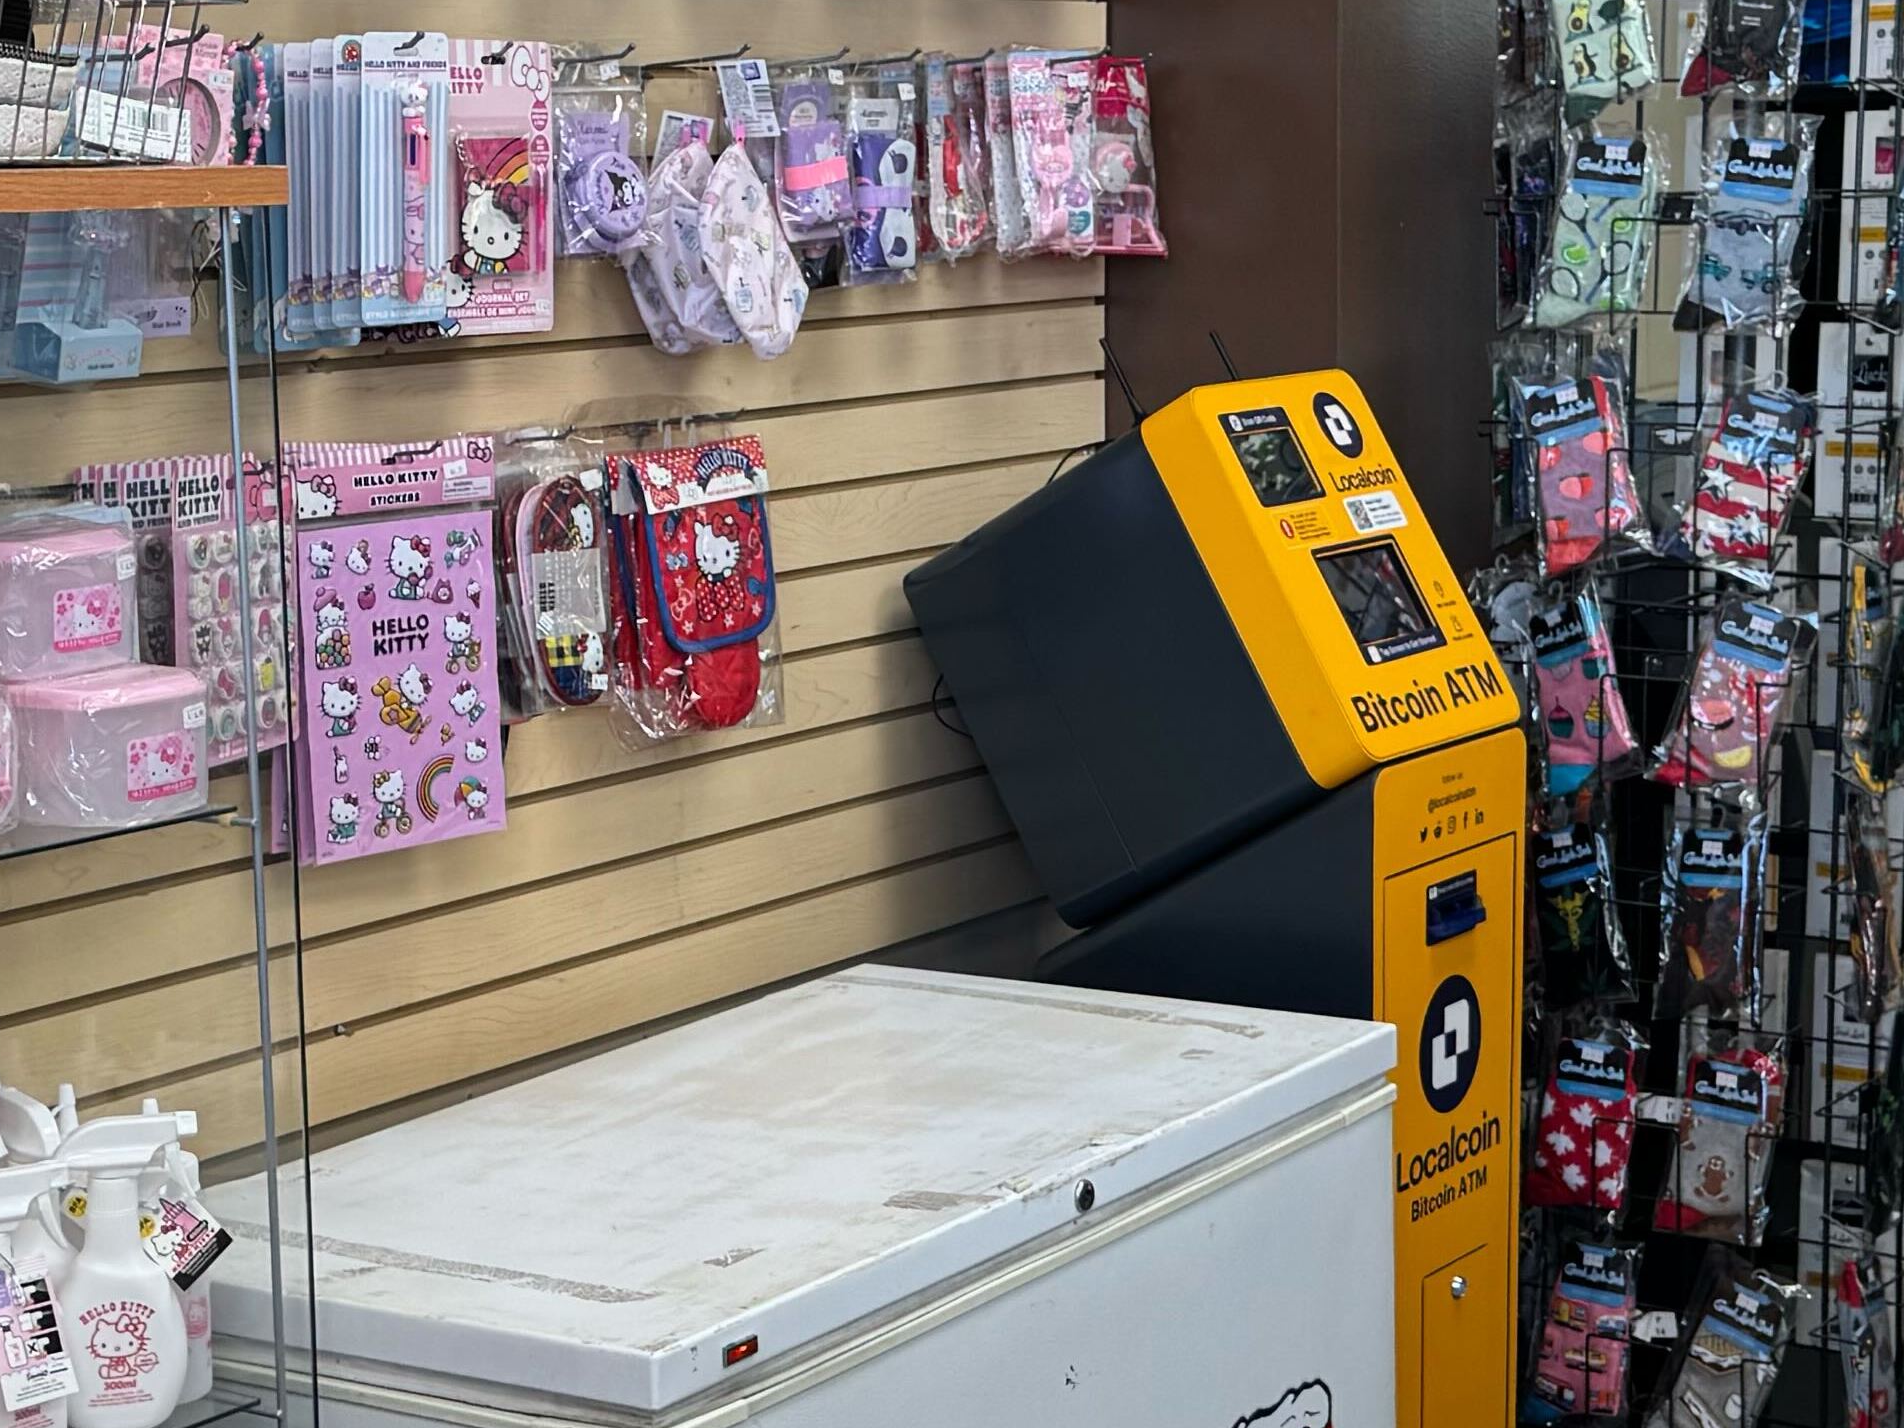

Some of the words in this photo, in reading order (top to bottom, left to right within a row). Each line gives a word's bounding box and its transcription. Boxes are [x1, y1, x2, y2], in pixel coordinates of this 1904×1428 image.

[697, 452, 724, 479] HELLO
[724, 449, 748, 469] KITTY
[126, 479, 172, 500] HELL
[178, 474, 220, 498] HELLO
[354, 473, 394, 488] HELLO
[398, 470, 438, 484] KITTY
[1329, 464, 1398, 493] Localcoin
[126, 499, 172, 518] KITT
[177, 495, 221, 518] KITTY
[370, 492, 420, 507] STICKERS
[372, 614, 430, 637] HELLO
[373, 633, 430, 657] KITTY
[1351, 680, 1448, 733] Bitcoin
[1443, 660, 1504, 708] ATM
[1396, 1111, 1500, 1192] Localcoin
[1411, 1183, 1454, 1222] Bitcoin
[1457, 1166, 1487, 1197] ATM
[79, 1302, 117, 1326] HELLO
[120, 1301, 156, 1320] KITTY
[104, 1380, 137, 1391] 300ml
